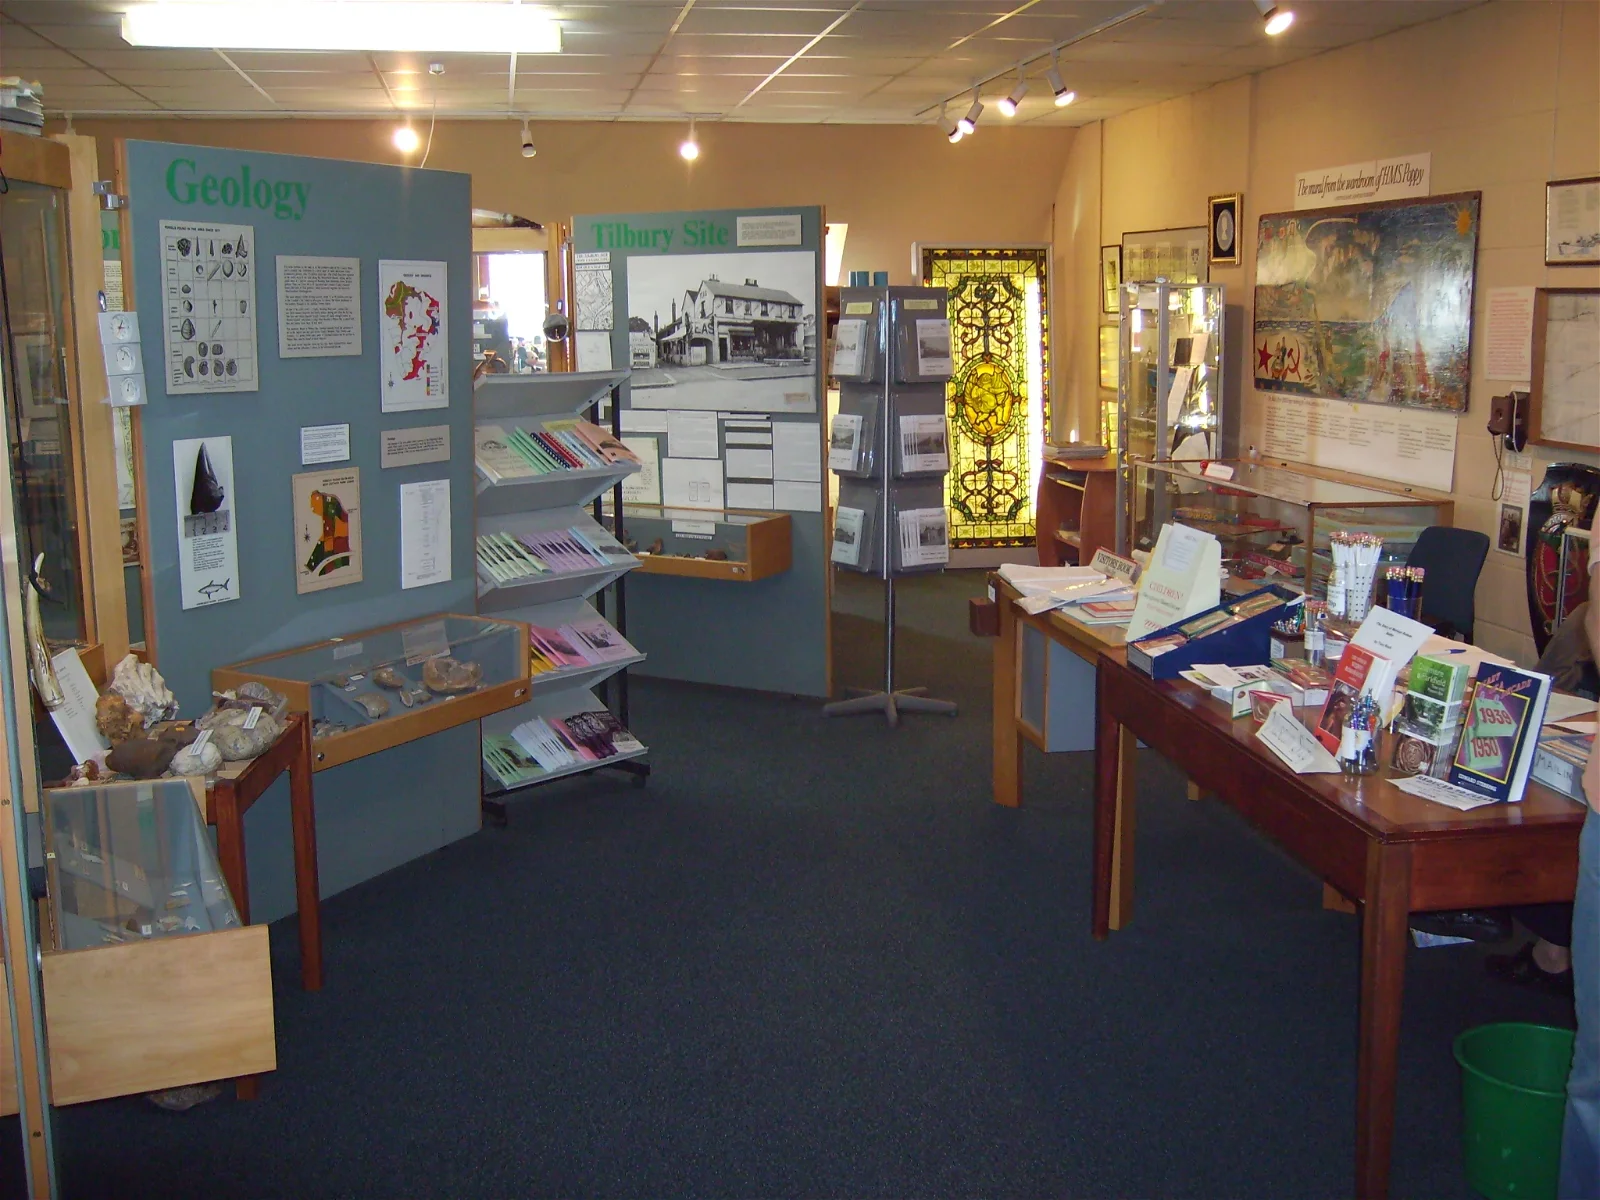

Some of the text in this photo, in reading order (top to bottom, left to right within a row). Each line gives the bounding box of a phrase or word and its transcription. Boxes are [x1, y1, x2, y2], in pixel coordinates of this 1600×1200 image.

[165, 158, 311, 220] Geology
[1298, 178, 1308, 196] The
[1308, 175, 1325, 194] mural
[1321, 175, 1336, 198] from
[1337, 173, 1345, 191] the
[1346, 169, 1375, 190] wardroom
[1382, 164, 1403, 185] HMS
[1402, 162, 1424, 187] Poppy
[591, 223, 674, 252] Tilbury
[683, 220, 728, 246] Site
[1117, 560, 1133, 575] BOOK
[1479, 707, 1513, 725] 1939
[1471, 736, 1499, 758] 1950
